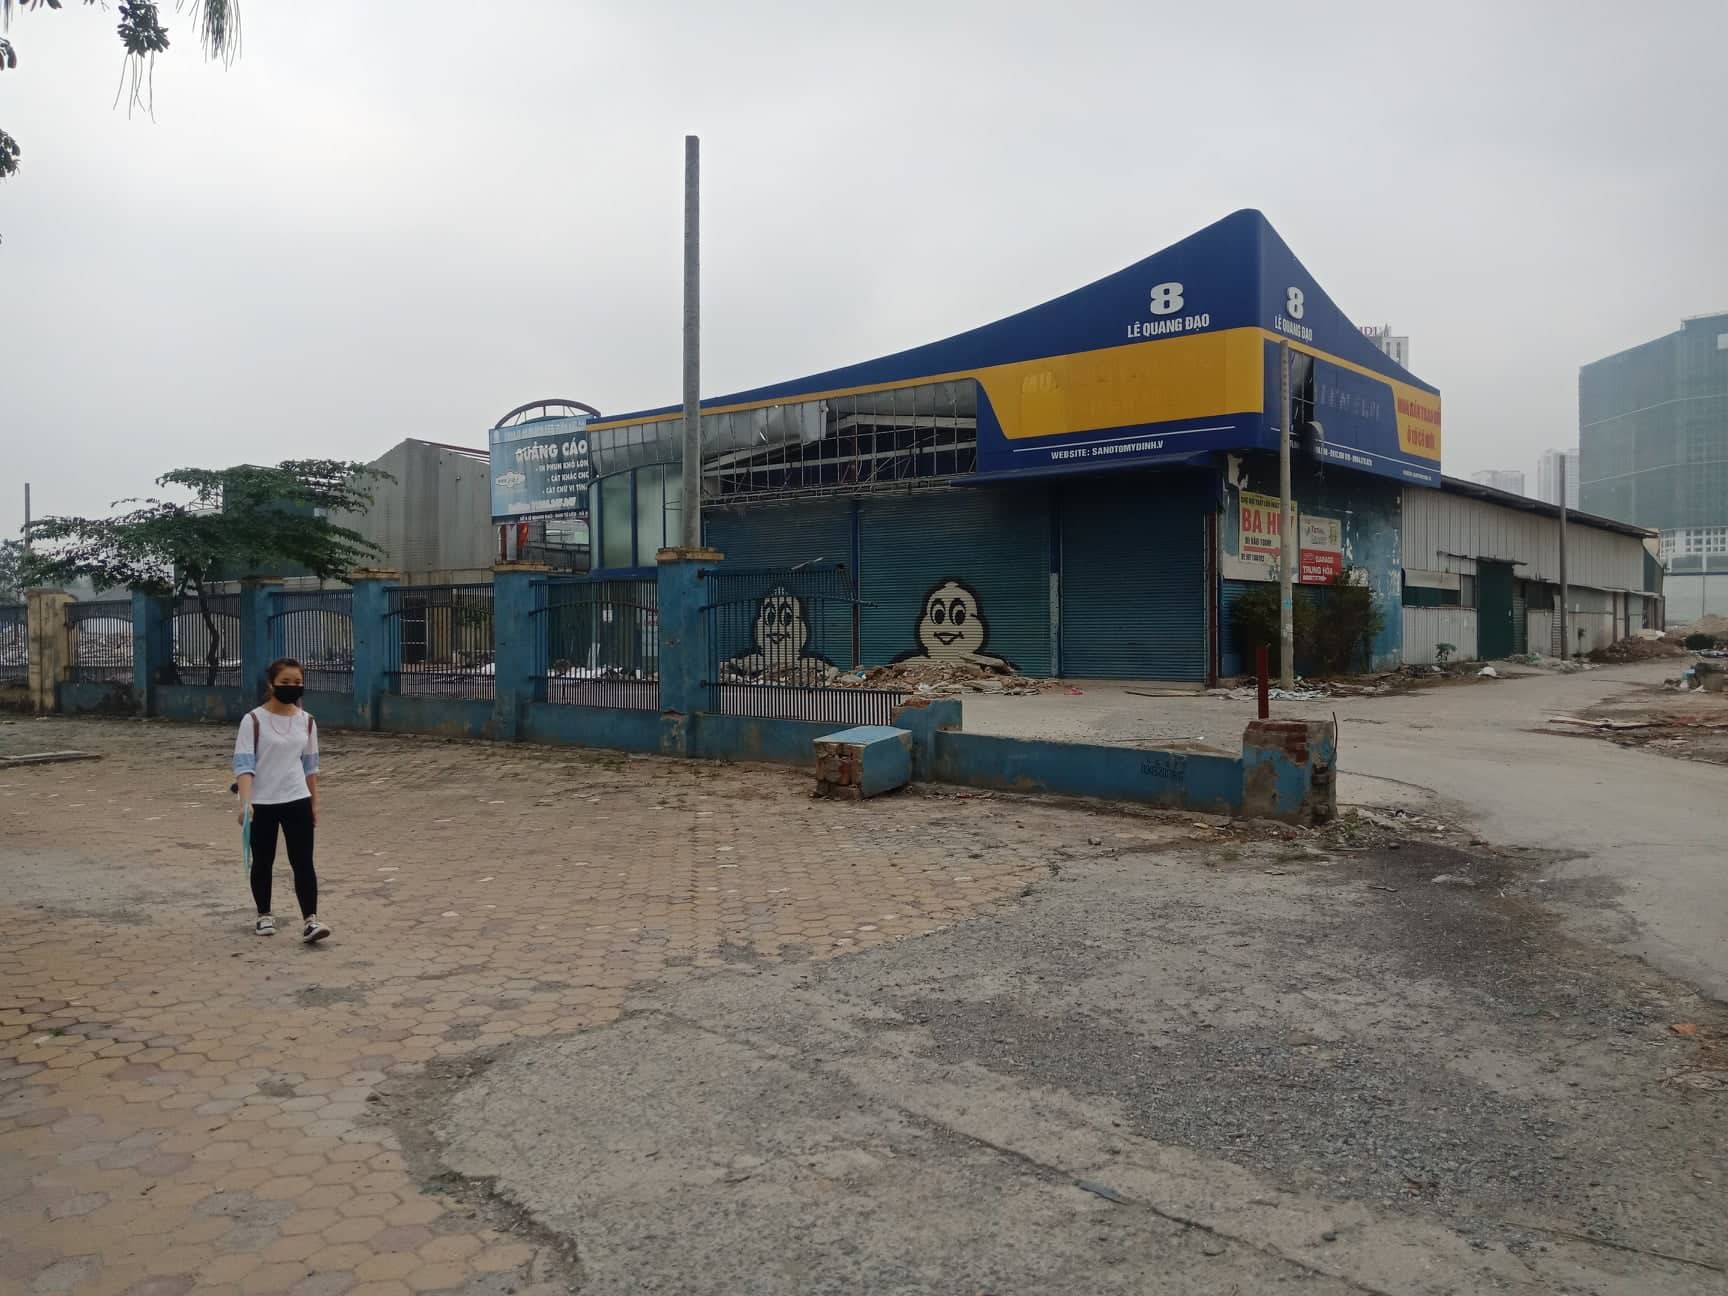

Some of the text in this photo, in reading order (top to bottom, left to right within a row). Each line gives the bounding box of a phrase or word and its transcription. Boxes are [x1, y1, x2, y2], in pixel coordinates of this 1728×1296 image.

[1150, 281, 1184, 315] 8
[1286, 286, 1304, 320] 8
[1127, 313, 1210, 338] LÊ QUANG ĐẠO
[1274, 315, 1282, 330] LÊ
[1282, 318, 1302, 338] QUANG
[562, 437, 588, 457] CÁO
[1051, 448, 1090, 460] WEBSITE:
[1242, 508, 1263, 533] BA
[1302, 565, 1321, 574] TRUNG
